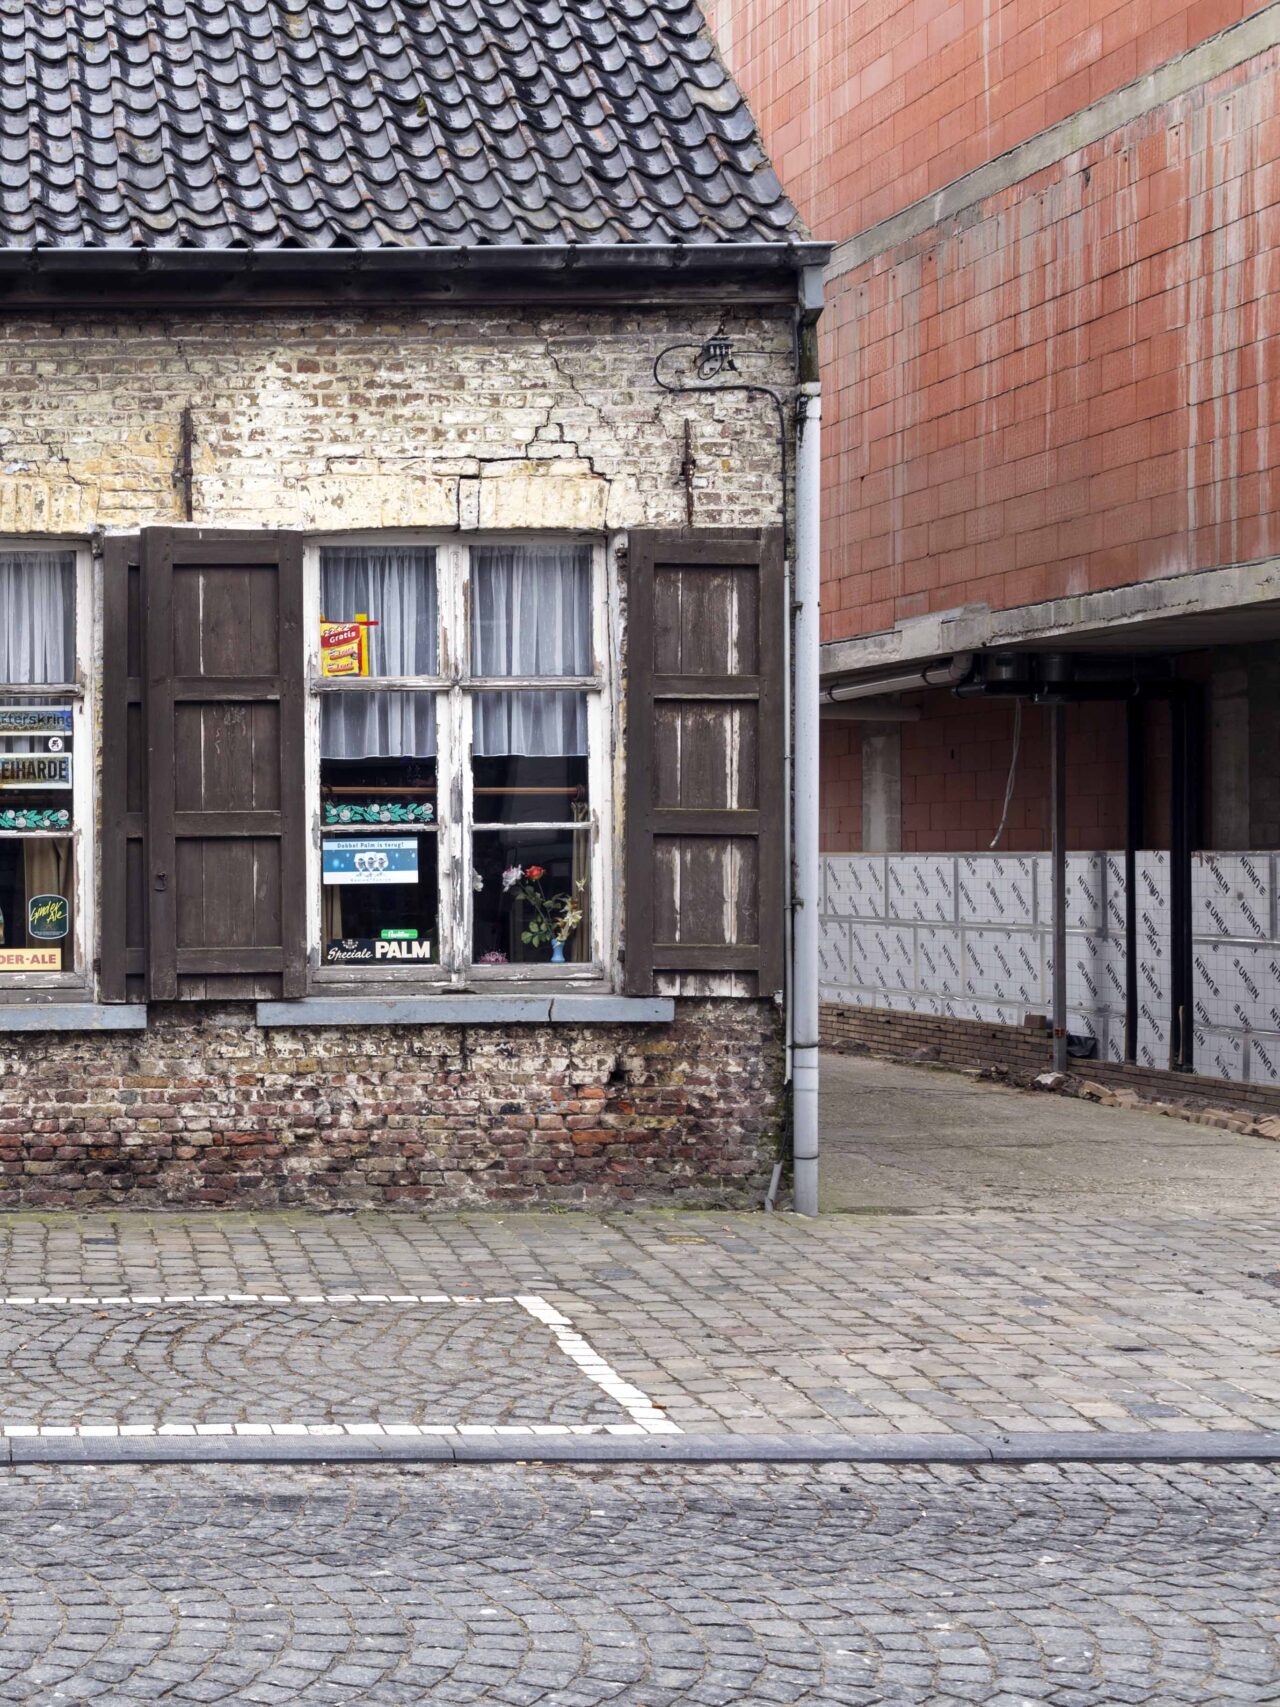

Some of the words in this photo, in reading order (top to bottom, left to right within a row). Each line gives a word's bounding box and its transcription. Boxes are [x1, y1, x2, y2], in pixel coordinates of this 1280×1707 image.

[329, 631, 356, 643] Gratis
[1107, 858, 1125, 888] UNILIN
[1240, 856, 1261, 888] UNILIN
[1078, 875, 1094, 904] UNILIN
[29, 901, 63, 924] Ginder
[47, 910, 67, 923] Ale
[1108, 899, 1125, 929] UNILIN
[1240, 902, 1261, 934] UNILIN
[327, 947, 373, 961] Speciale
[375, 941, 430, 958] PALM
[1106, 963, 1122, 994] UNILIN
[1140, 962, 1158, 993] UNILIN
[1194, 957, 1214, 990] UNILIN
